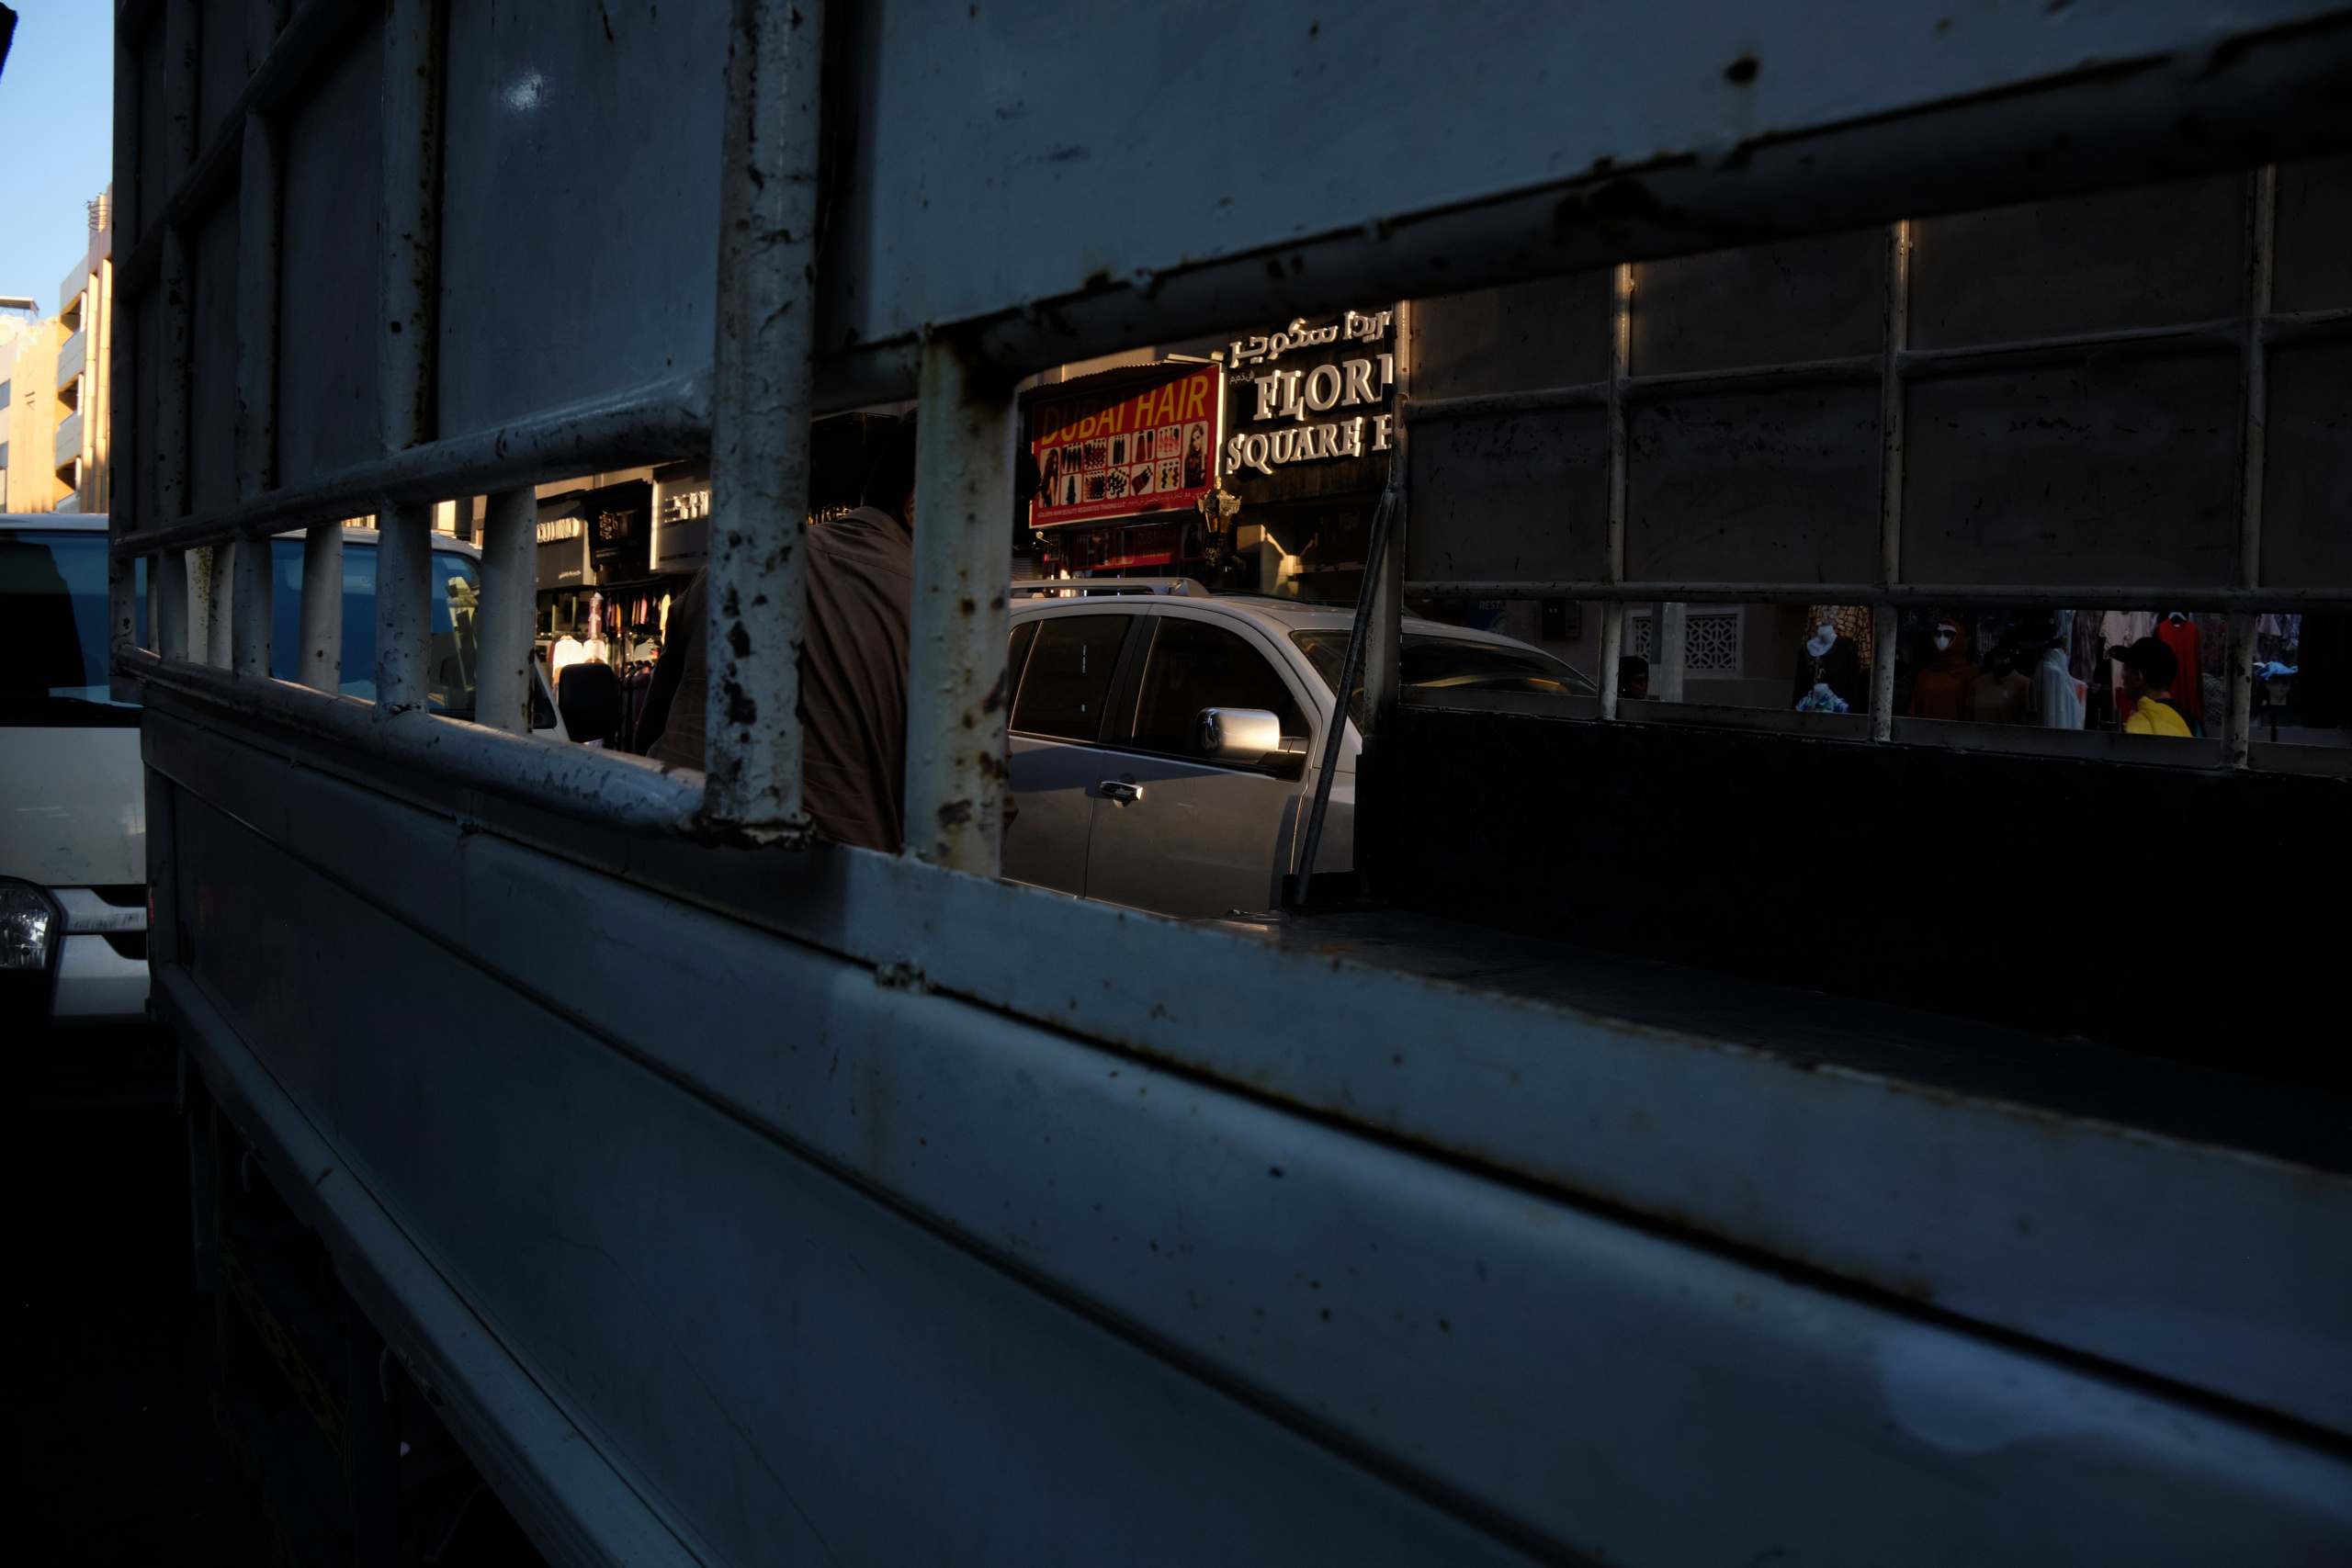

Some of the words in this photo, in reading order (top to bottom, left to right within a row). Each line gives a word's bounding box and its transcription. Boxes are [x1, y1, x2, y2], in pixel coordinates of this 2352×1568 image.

[1041, 392, 1127, 446] DUBAI
[1134, 375, 1209, 430] HAIR
[1226, 416, 1363, 476] SQUARE
[1062, 507, 1077, 515] BEAUTY
[1100, 502, 1117, 512] TRADING
